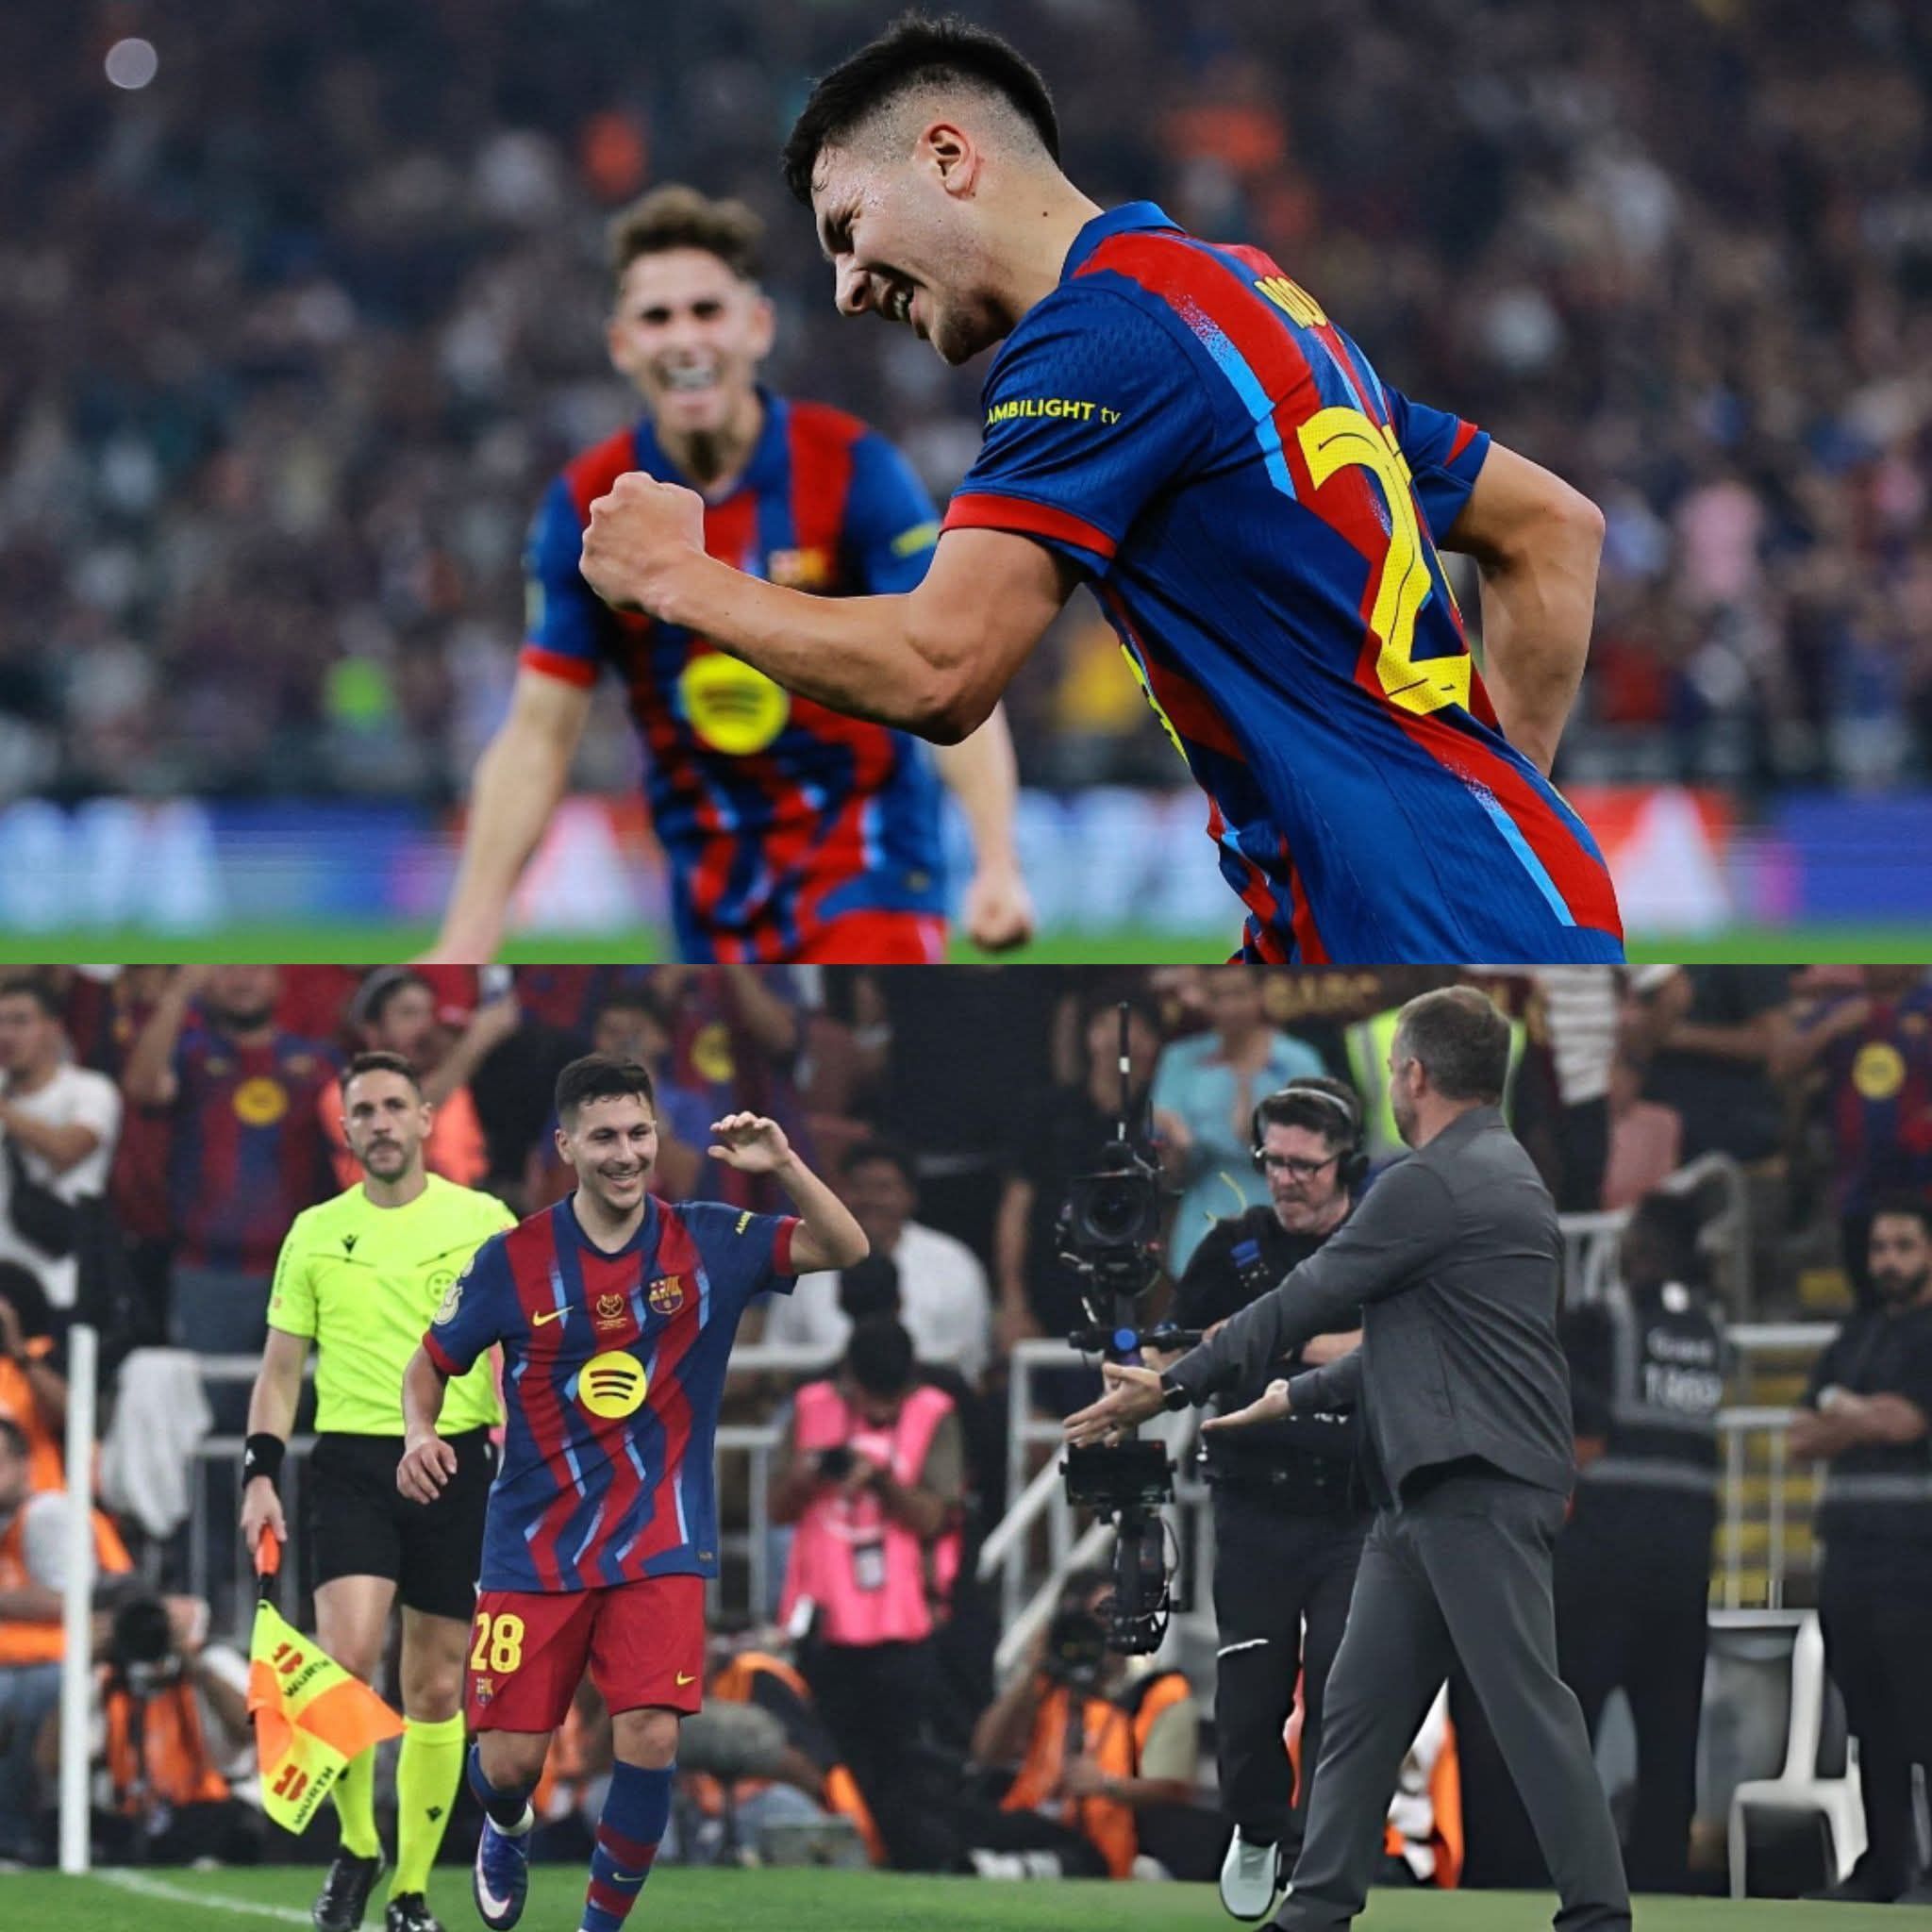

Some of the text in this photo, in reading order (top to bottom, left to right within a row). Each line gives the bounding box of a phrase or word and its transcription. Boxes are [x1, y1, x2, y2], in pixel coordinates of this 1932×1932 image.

[986, 399, 1121, 425] AMBILIGHT tv
[1297, 406, 1471, 716] 2
[471, 1612, 525, 1674] 28
